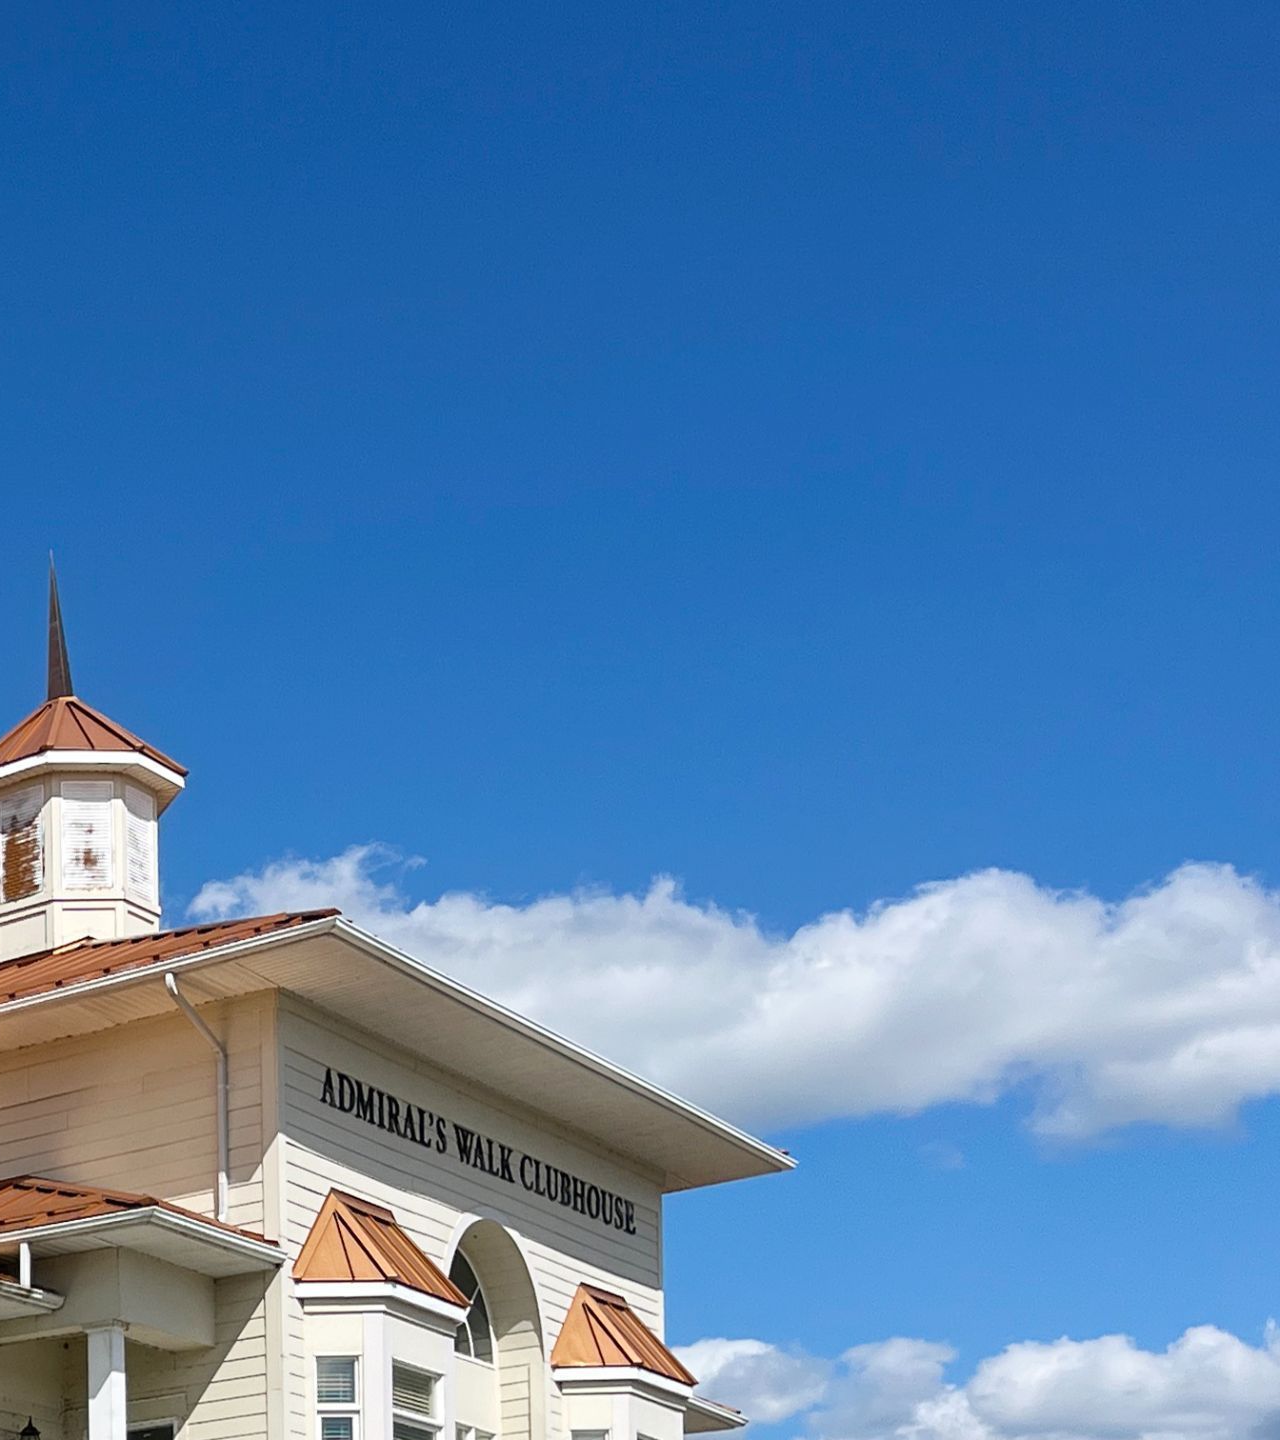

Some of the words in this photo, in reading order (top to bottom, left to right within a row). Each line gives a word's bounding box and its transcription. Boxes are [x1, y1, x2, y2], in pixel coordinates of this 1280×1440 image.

[320, 1067, 447, 1154] ADMIRAL'S
[452, 1123, 515, 1183] WALK
[519, 1154, 637, 1235] CLUBHOUSE
